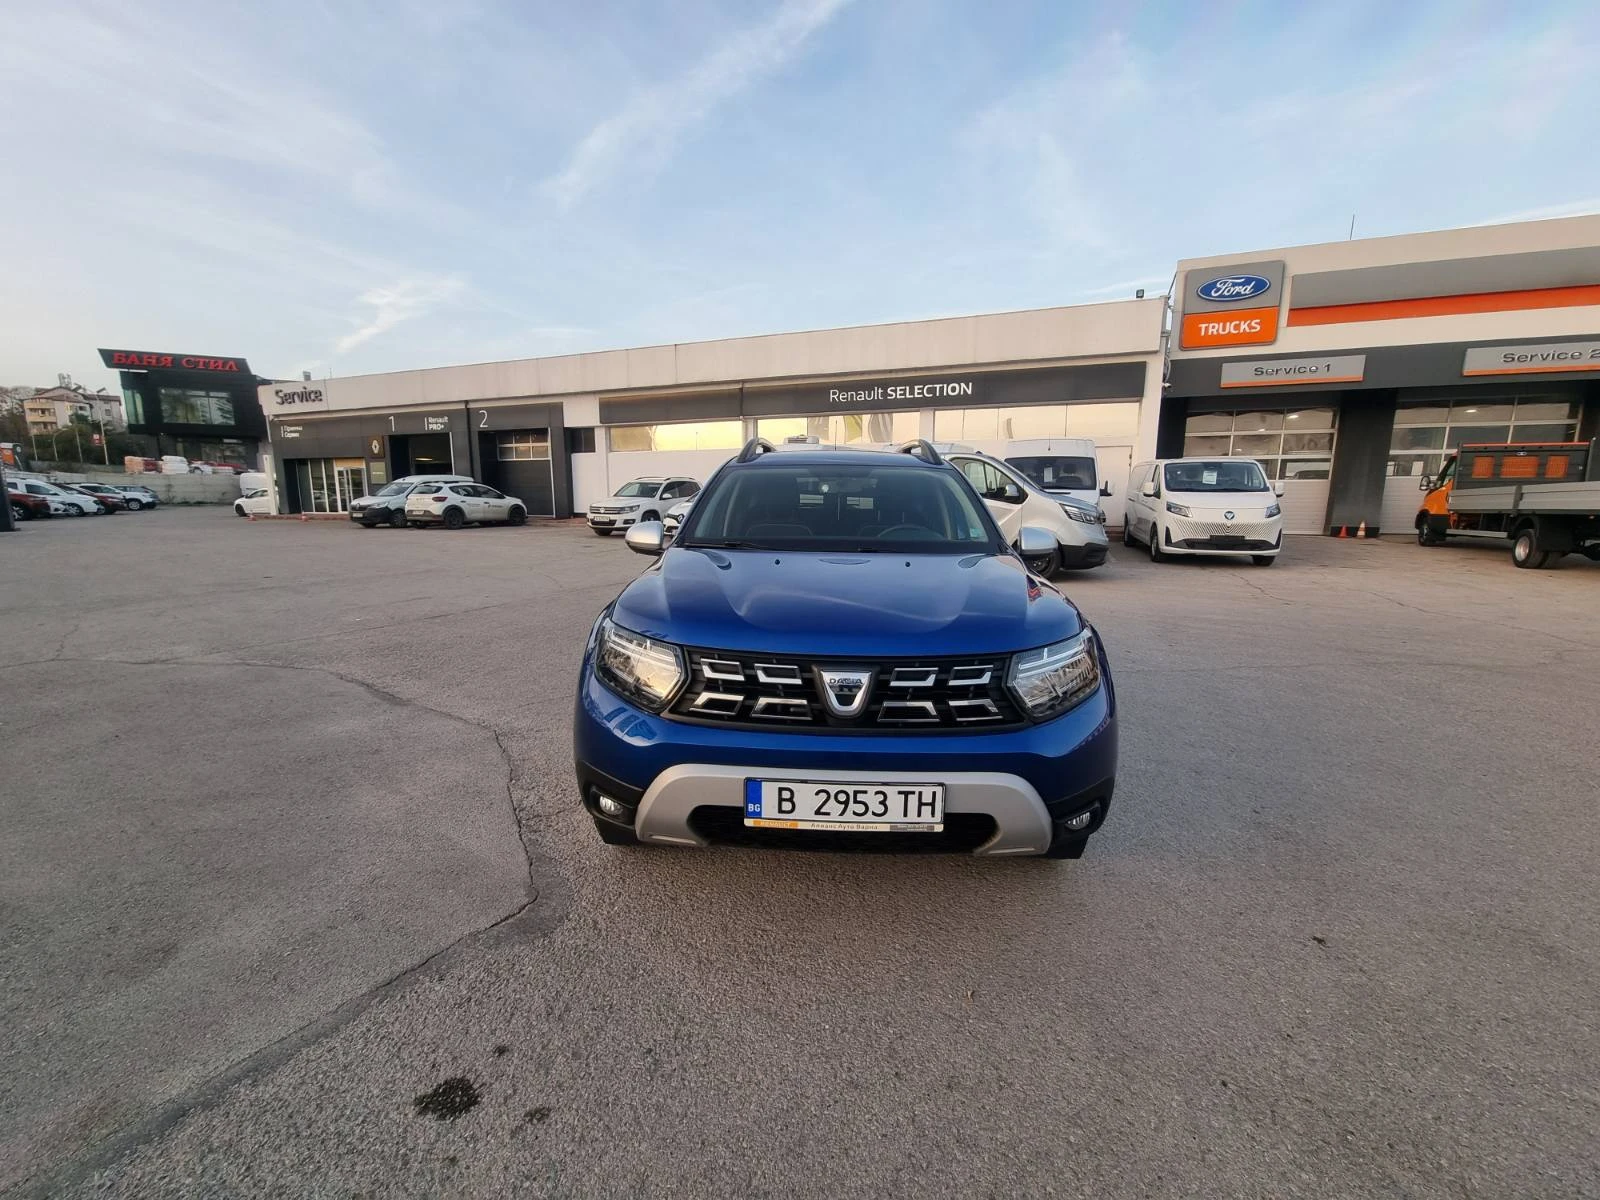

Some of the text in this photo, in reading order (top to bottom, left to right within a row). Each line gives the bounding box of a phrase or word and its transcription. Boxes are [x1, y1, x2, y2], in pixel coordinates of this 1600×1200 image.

[1211, 278, 1254, 297] Ford
[1199, 319, 1261, 337] TRUCKS
[112, 352, 241, 372] БАНЯ СТИЛ
[1502, 350, 1583, 363] Service
[1254, 363, 1331, 376] Service 1
[275, 386, 323, 406] Service
[829, 382, 973, 403] Renault SELECTION
[388, 415, 396, 432] 1
[479, 410, 488, 428] 2
[748, 803, 761, 813] BG
[777, 786, 937, 818] B 2953 TH
